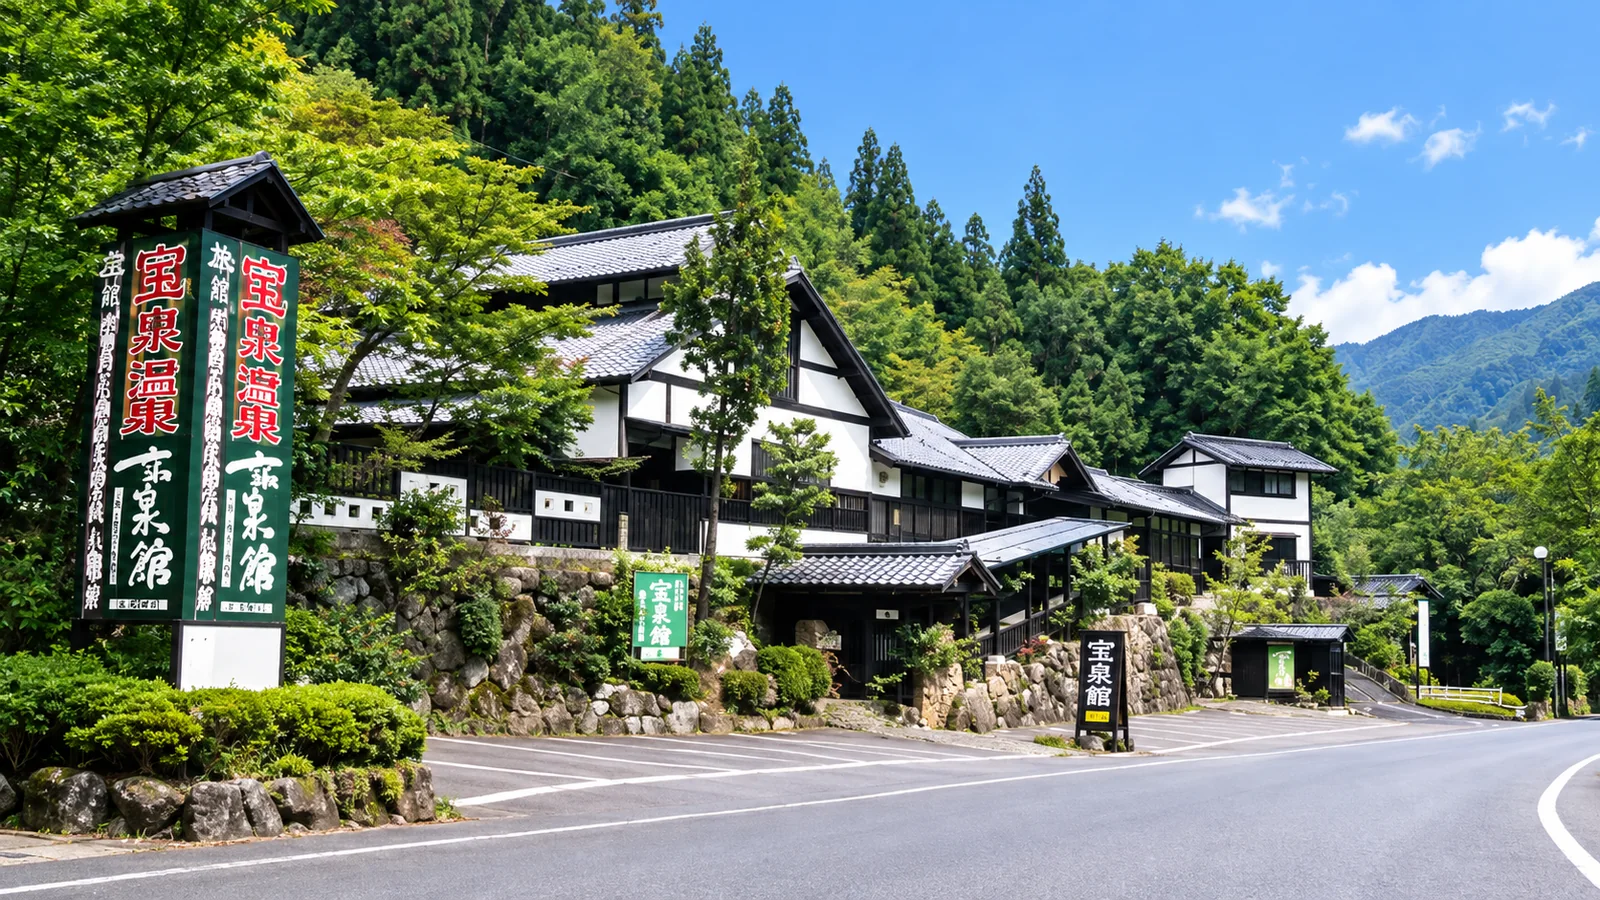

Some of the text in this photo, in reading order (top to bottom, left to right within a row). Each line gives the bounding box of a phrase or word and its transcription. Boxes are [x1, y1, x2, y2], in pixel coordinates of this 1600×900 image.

[121, 243, 186, 434] 宝泉温泉
[649, 578, 672, 646] 宝泉館
[1085, 639, 1115, 707] 宝泉館
